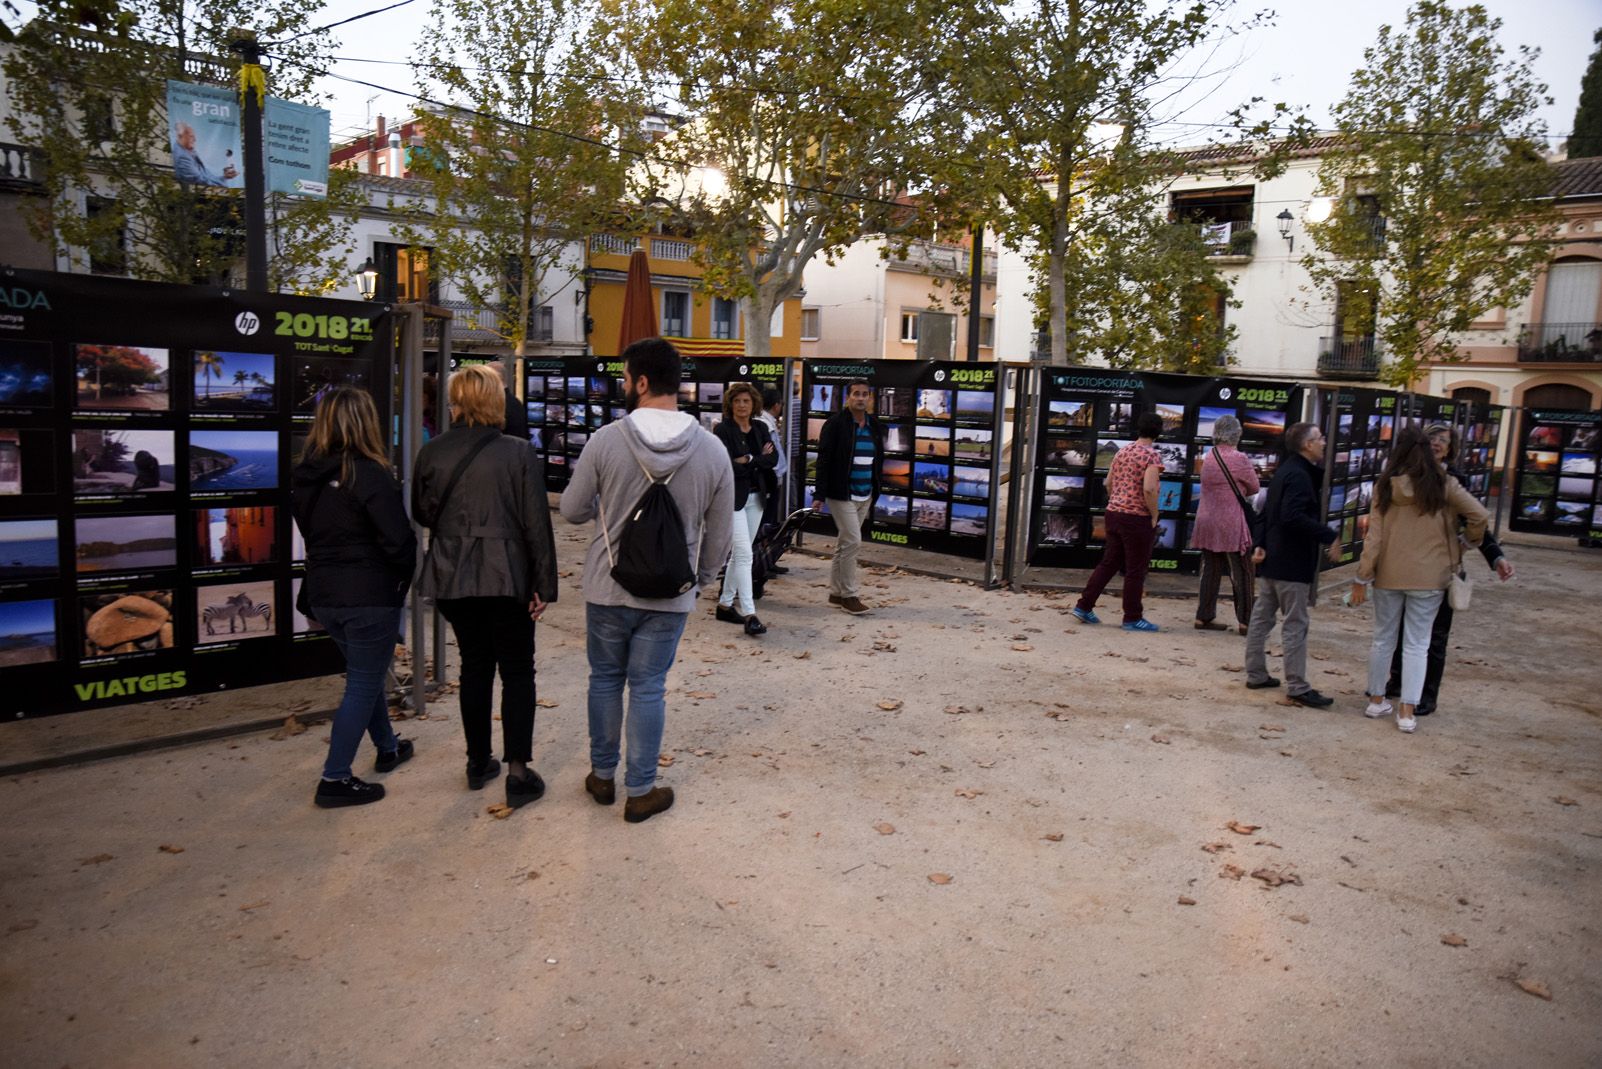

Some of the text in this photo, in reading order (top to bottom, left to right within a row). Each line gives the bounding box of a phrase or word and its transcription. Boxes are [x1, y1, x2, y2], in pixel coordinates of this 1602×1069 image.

[192, 101, 230, 117] gran
[235, 312, 259, 336] hp
[275, 311, 348, 340] 2018
[751, 363, 776, 375] 2018
[950, 369, 984, 382] 2018
[1071, 376, 1145, 389] FOTOPORTADA
[1236, 387, 1274, 402] 2018
[871, 530, 908, 544] VIATGES
[1148, 559, 1178, 569] TGES
[74, 671, 187, 701] VIATGES
